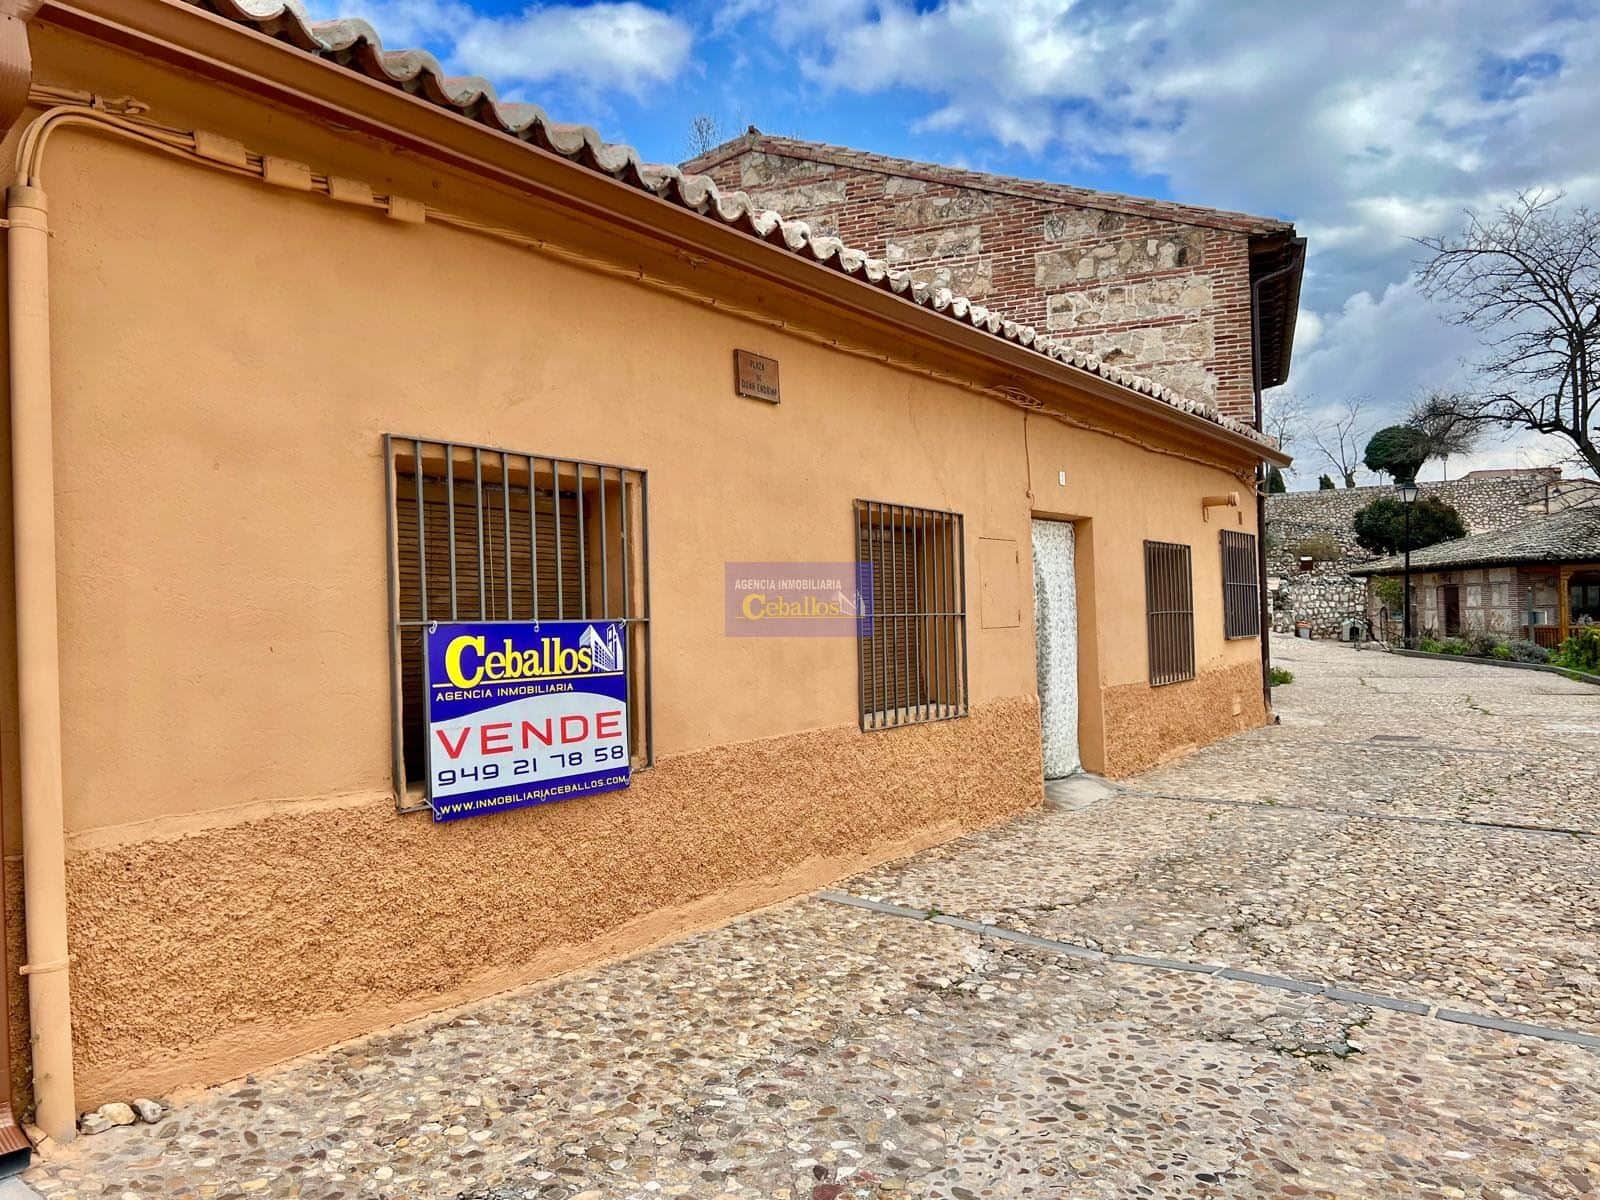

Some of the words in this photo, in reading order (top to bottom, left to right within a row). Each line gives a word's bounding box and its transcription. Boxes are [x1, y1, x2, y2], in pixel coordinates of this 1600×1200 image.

[445, 635, 592, 689] Ceballos
[436, 690, 492, 702] AGENCIA
[497, 683, 574, 697] INMOBILIARIA
[436, 710, 622, 760] VENDE
[438, 764, 500, 787] 949
[513, 758, 537, 776] 21
[550, 752, 583, 769] 78
[594, 745, 625, 763] 58
[440, 776, 626, 815] WWW.INMOBILIARIACEBALLOS.COM
